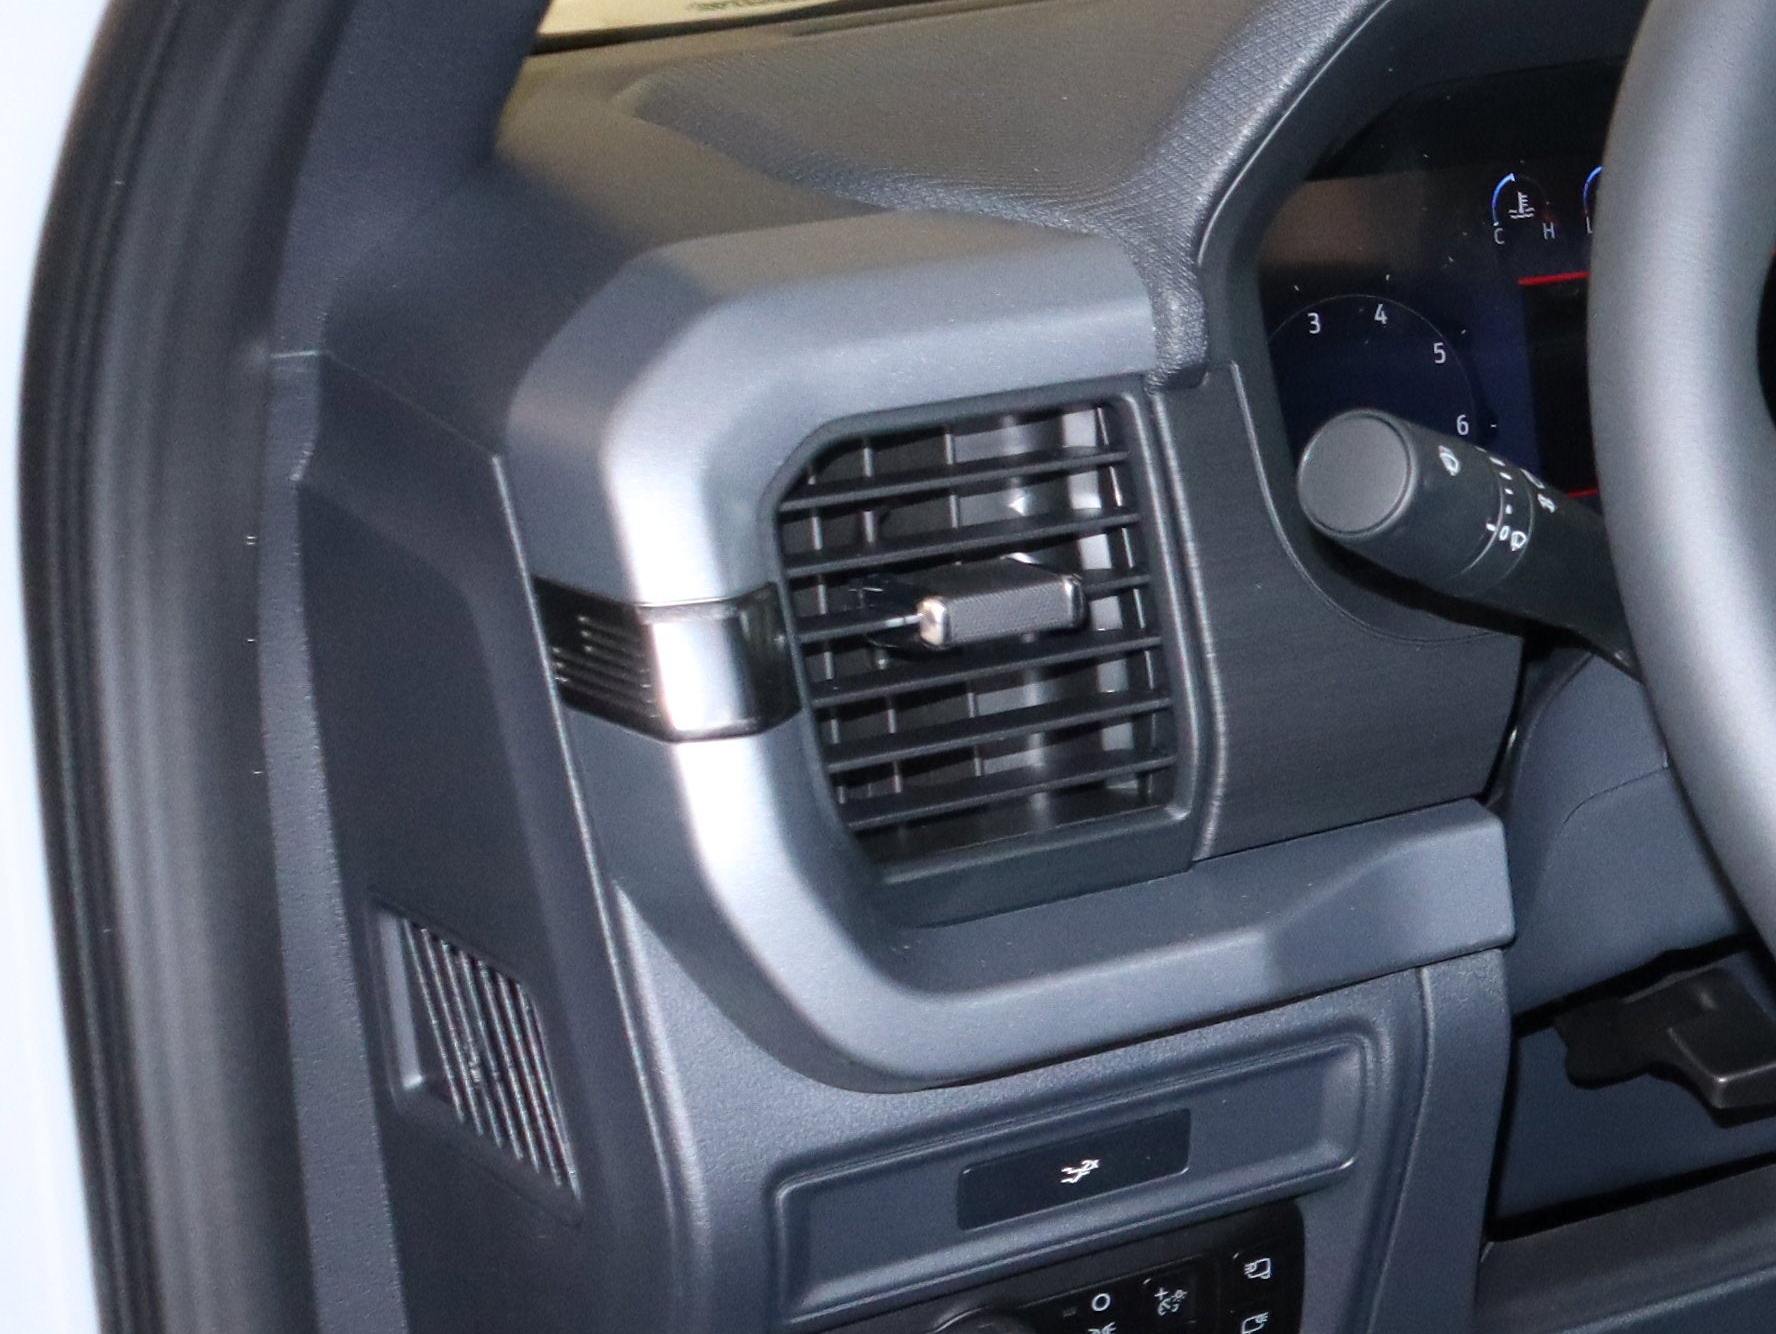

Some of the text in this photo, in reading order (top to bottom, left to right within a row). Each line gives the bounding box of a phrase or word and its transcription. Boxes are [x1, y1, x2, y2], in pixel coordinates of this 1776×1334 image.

[1494, 227, 1505, 245] C
[1542, 221, 1555, 240] H
[1307, 312, 1321, 334] 3
[1374, 303, 1388, 325] 4
[1433, 342, 1446, 364] 5
[1456, 414, 1469, 435] 6
